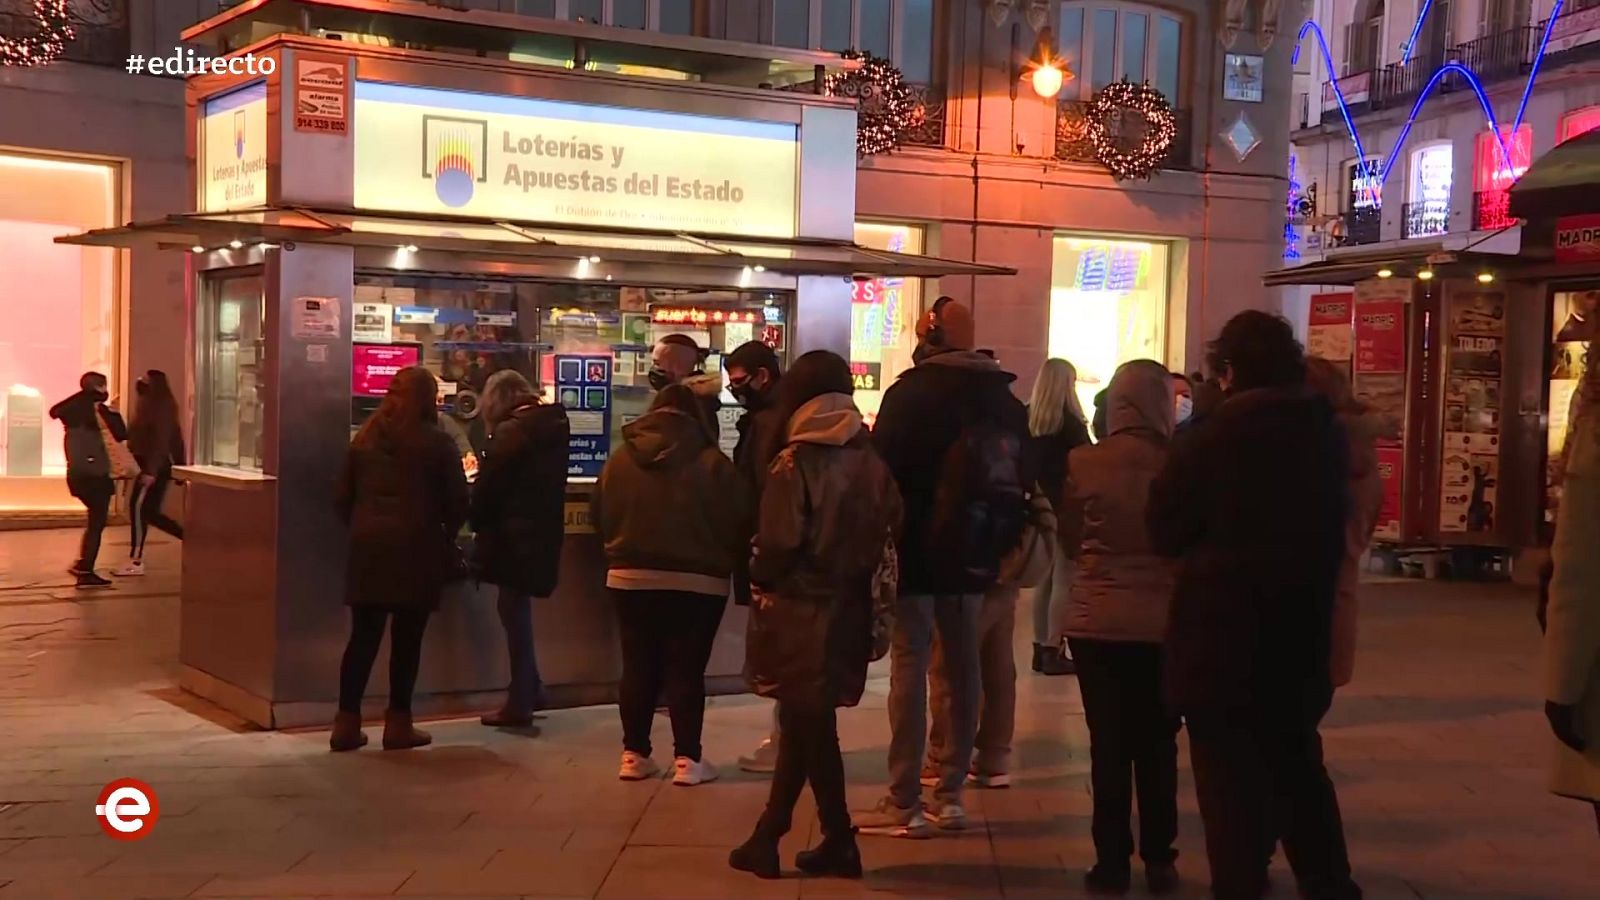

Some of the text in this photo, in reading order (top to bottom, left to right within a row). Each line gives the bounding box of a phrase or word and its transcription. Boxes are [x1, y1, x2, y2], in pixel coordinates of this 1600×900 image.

[503, 130, 625, 168] Loterías y
[503, 163, 744, 203] Apuestas del Estado
[655, 308, 706, 322] suerte
